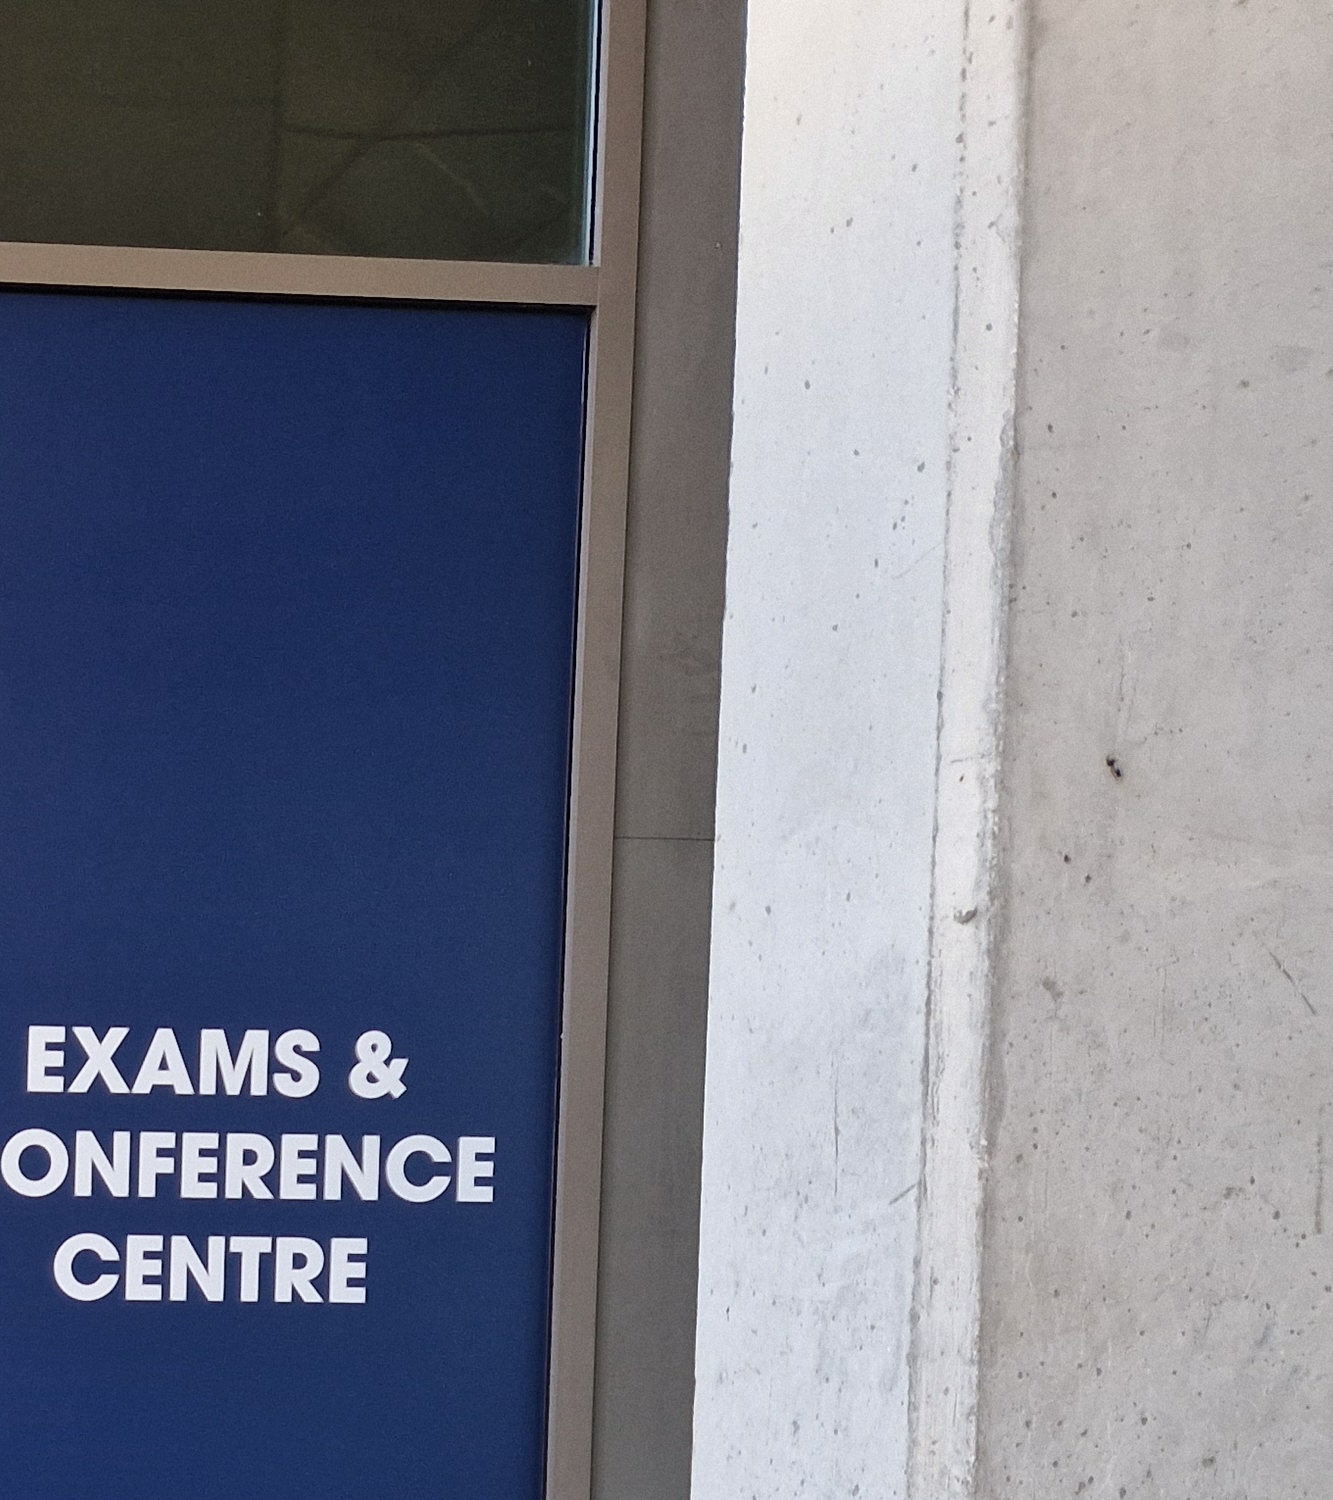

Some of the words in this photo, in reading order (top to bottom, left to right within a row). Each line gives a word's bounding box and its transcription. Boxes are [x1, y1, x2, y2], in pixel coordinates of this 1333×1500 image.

[26, 1025, 320, 1098] EXAMS
[348, 1030, 409, 1099] &
[53, 1232, 368, 1304] CENTRE
